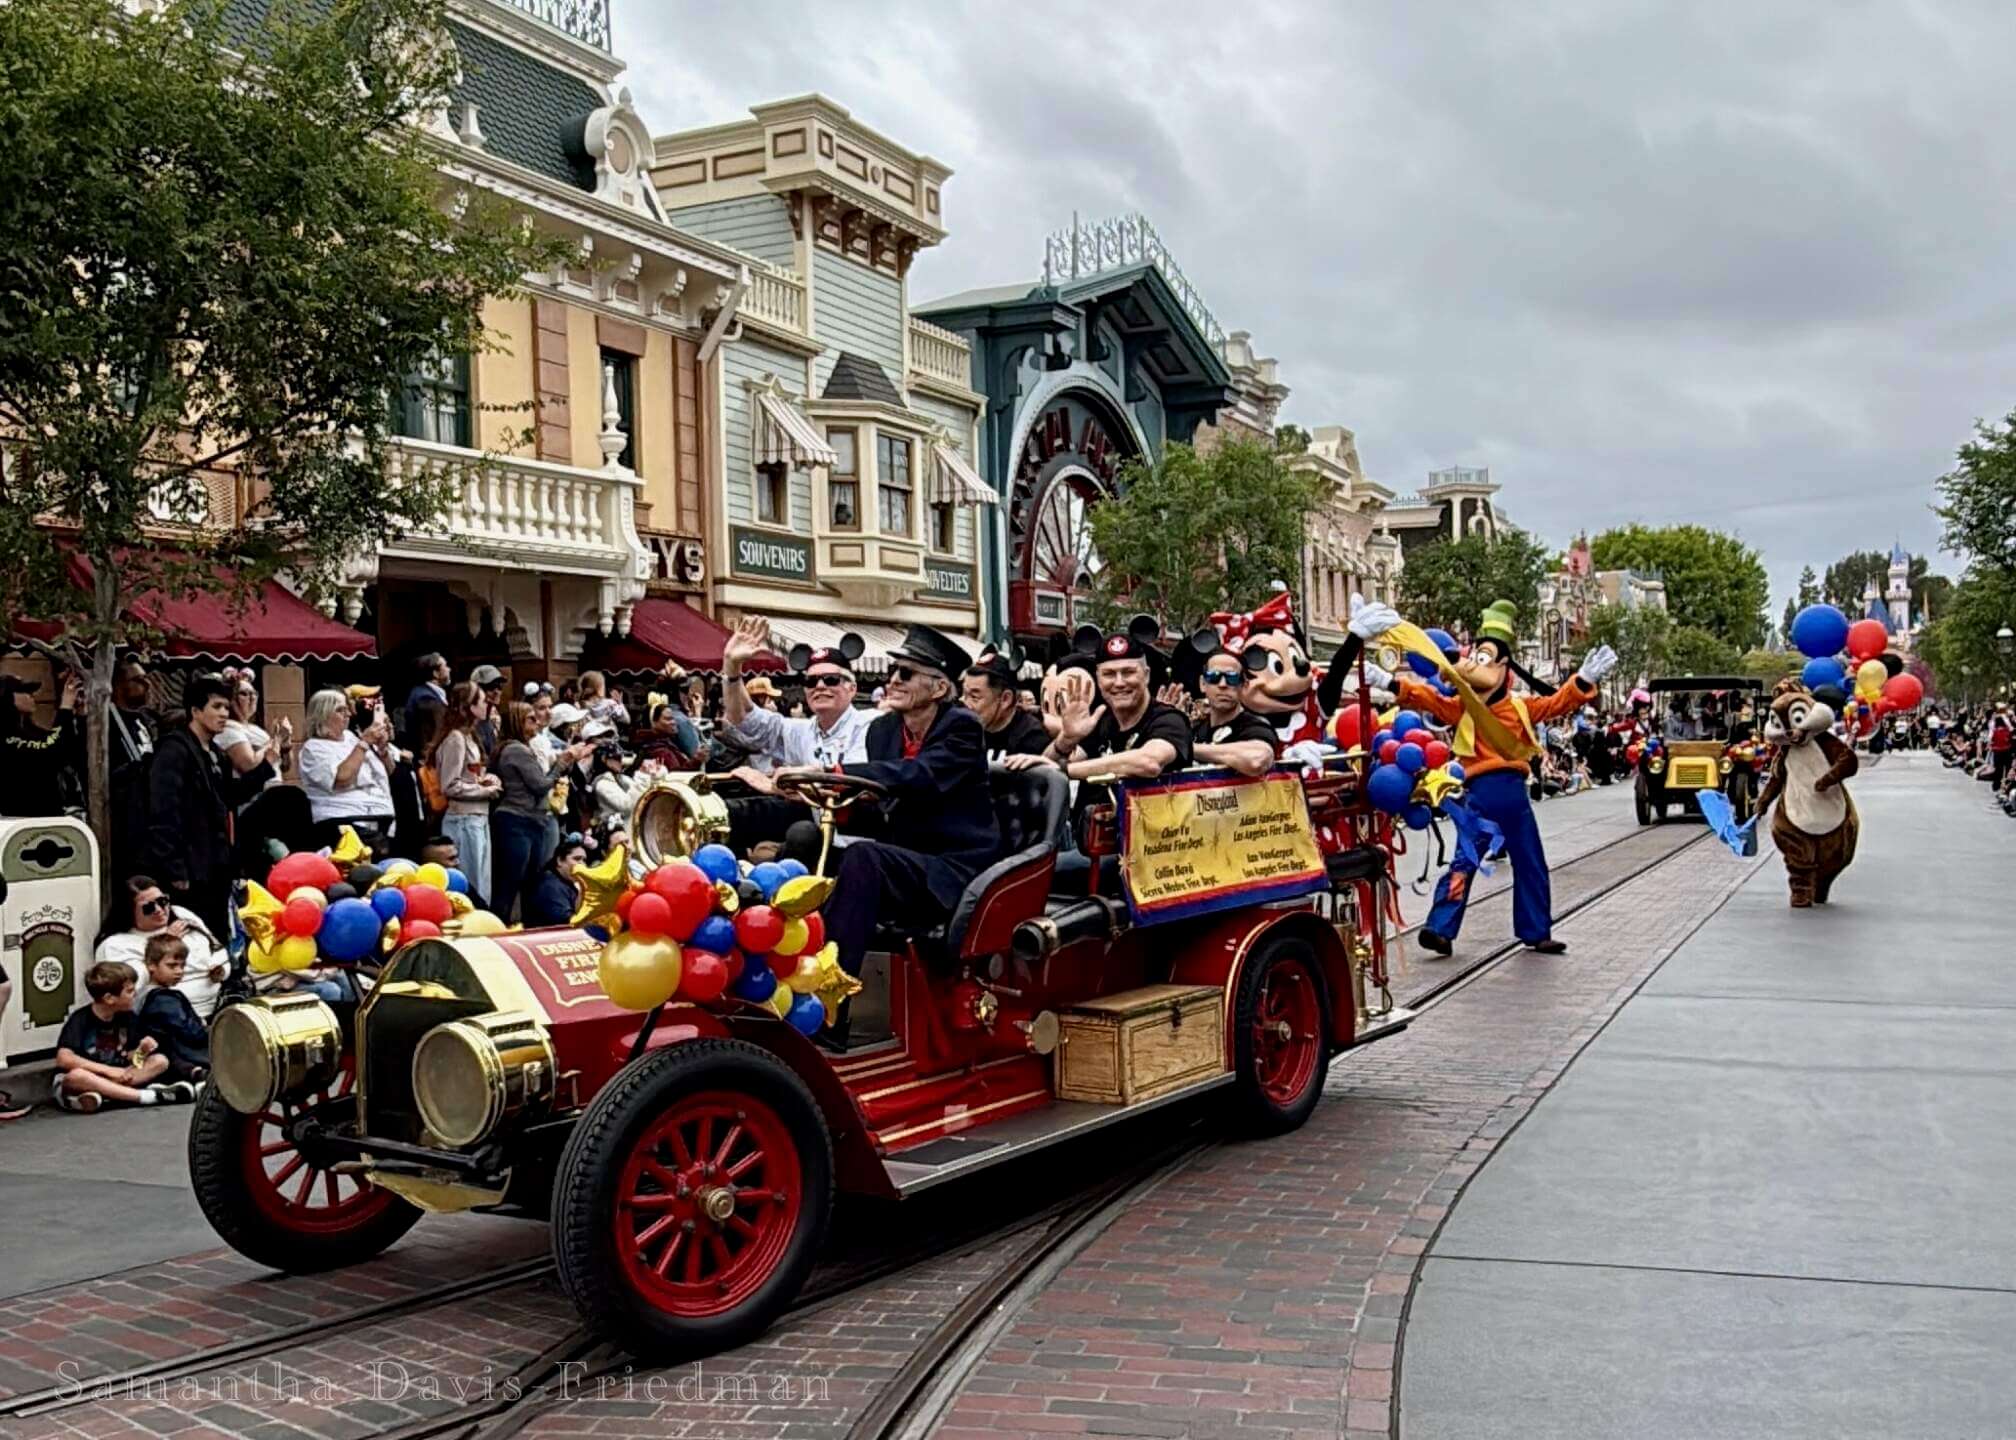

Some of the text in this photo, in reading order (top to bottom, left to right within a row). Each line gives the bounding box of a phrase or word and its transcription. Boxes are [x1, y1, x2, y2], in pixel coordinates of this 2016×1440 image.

[738, 540, 807, 573] SOUVENIRS
[1196, 789, 1239, 816] Disneyland
[1269, 823, 1282, 836] Fire
[1173, 839, 1187, 852] Fire
[1277, 861, 1290, 872] Fire
[1185, 877, 1201, 889] Fire
[535, 940, 604, 957] DISNE
